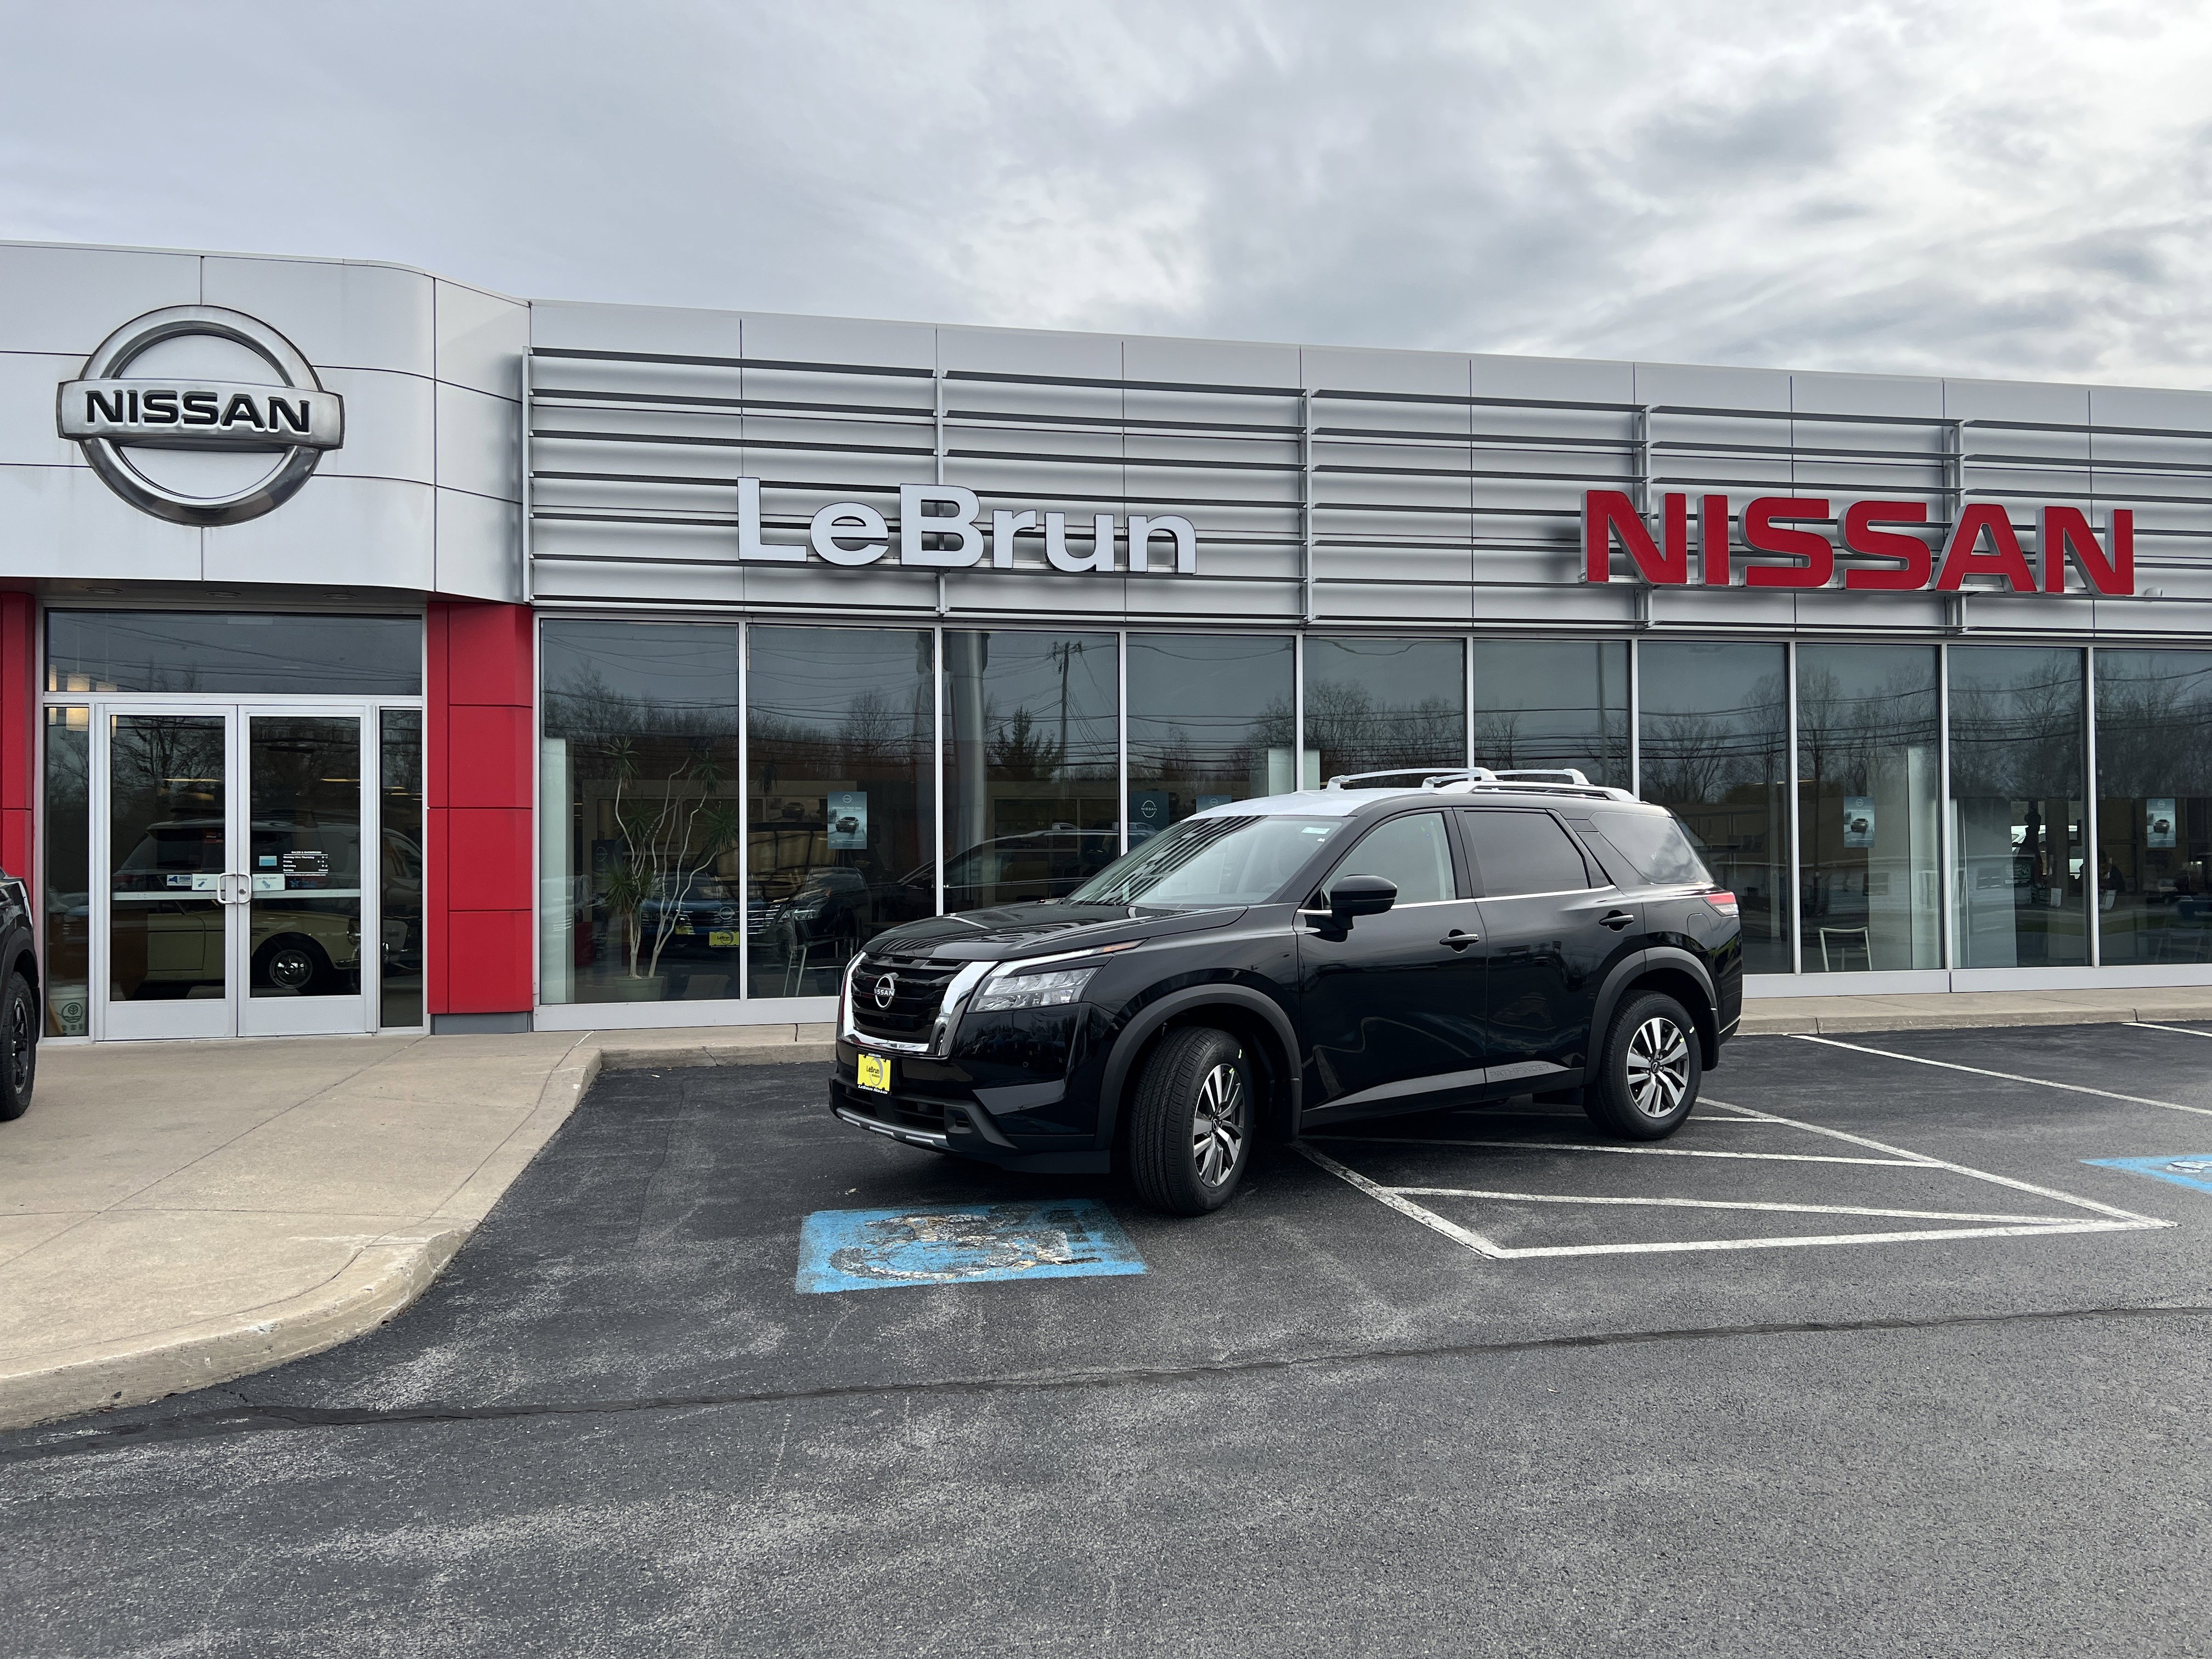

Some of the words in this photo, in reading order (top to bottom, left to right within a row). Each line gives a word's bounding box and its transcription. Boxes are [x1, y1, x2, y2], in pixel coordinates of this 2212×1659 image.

[86, 390, 312, 433] NISSAN
[737, 476, 1198, 573] LeBrun
[1581, 489, 2134, 595] NISSAN
[876, 988, 895, 996] SSAN
[866, 1065, 880, 1074] LeBrun
[1488, 1063, 1551, 1079] PATHFINDER
